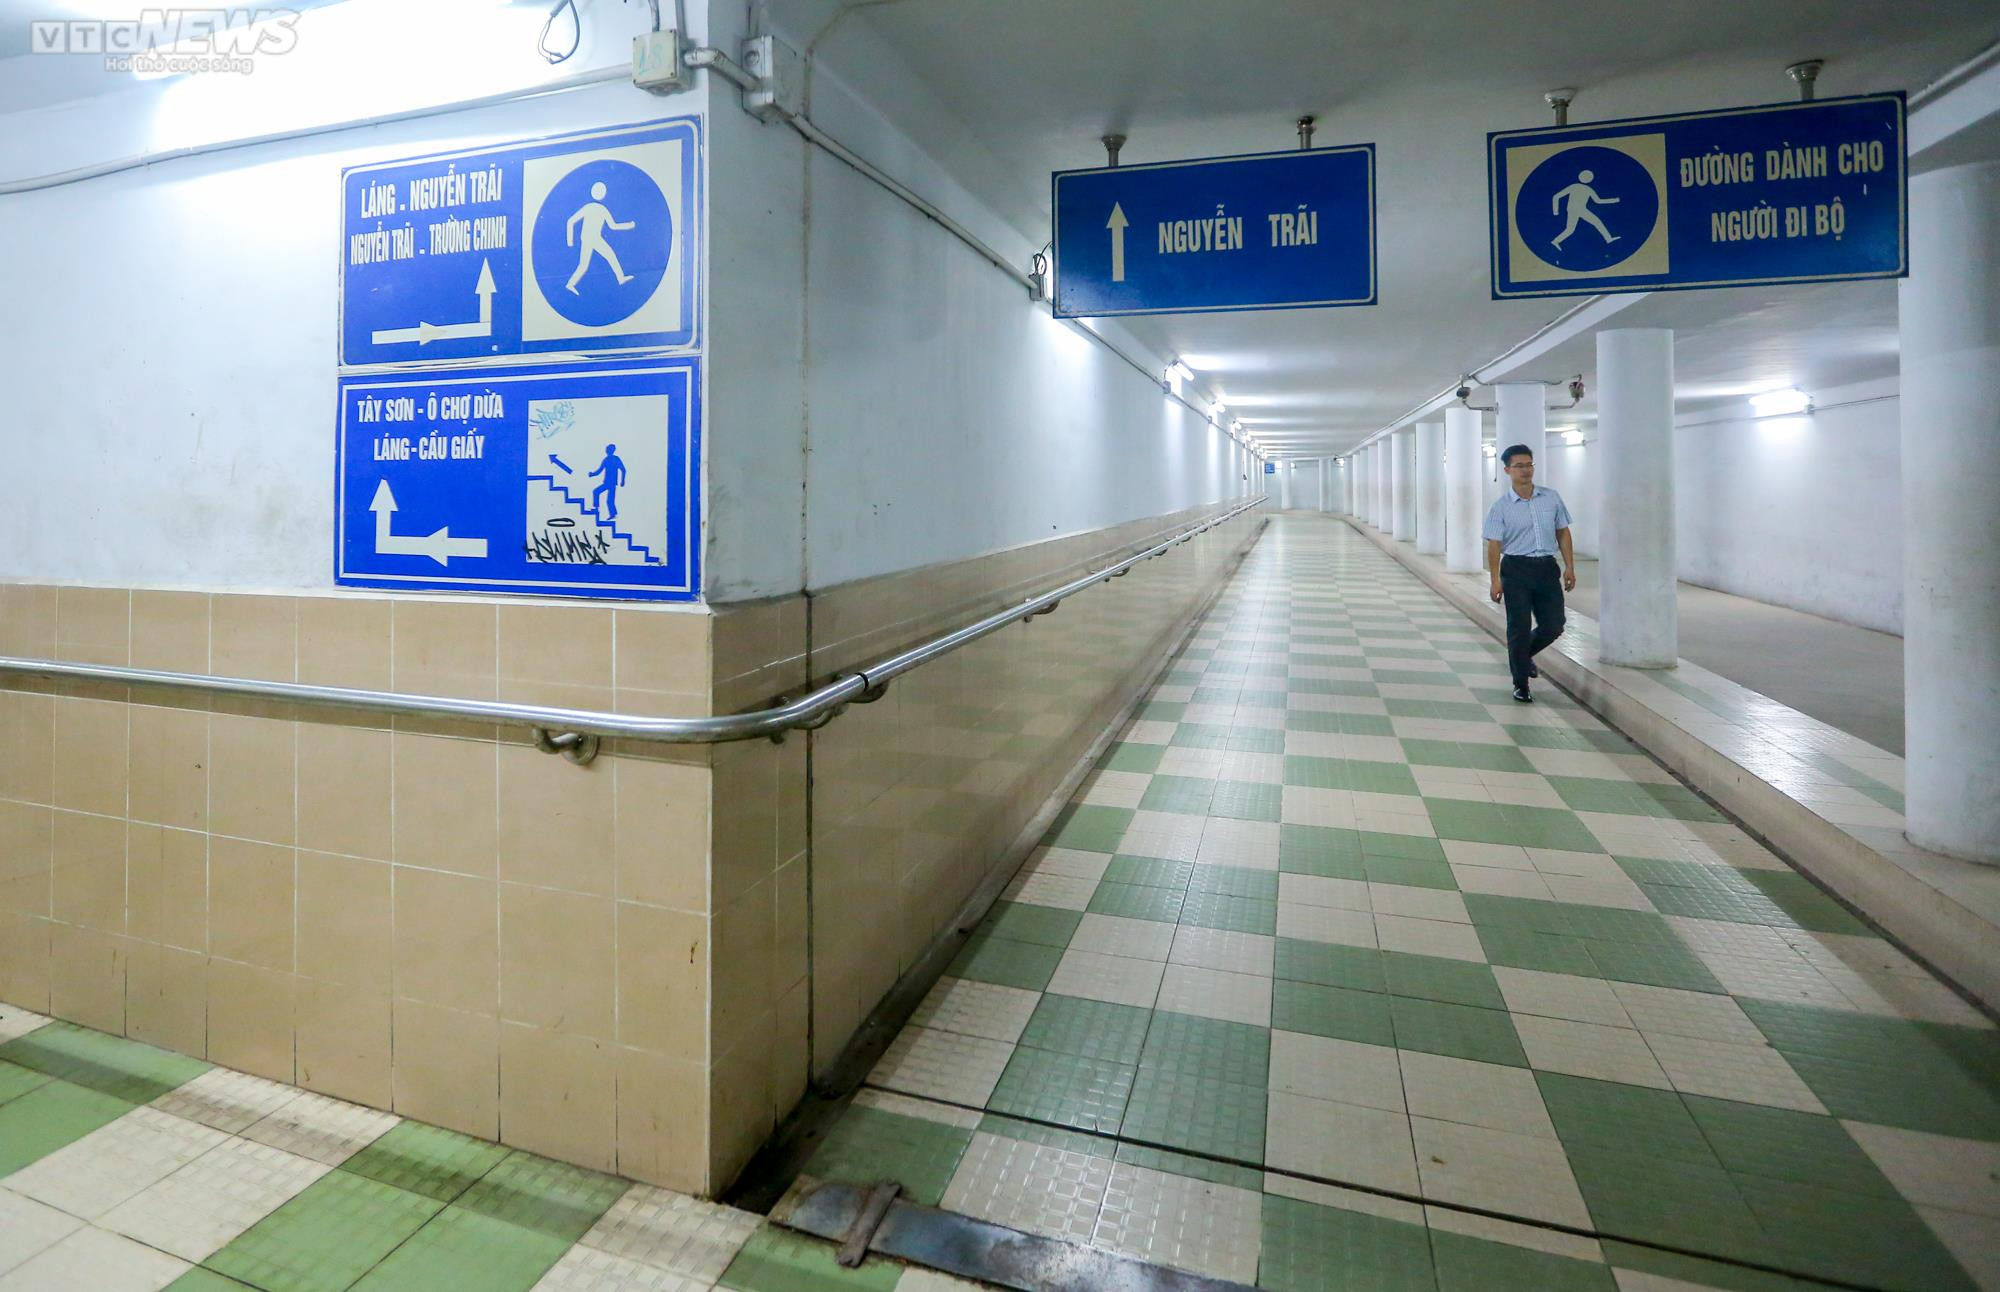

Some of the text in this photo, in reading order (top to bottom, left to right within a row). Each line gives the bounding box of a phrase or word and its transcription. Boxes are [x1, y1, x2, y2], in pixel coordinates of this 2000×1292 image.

[1680, 140, 1884, 188] ĐƯỜNG DÀNH CHO
[361, 180, 396, 219] LÁNG
[410, 163, 466, 211] NGUYỄN
[470, 163, 503, 204] TRÃI
[350, 221, 389, 265] NGUYỄN
[392, 221, 415, 260] TRÃI
[429, 214, 471, 255] TRƯỜNG
[473, 215, 507, 250] CHINH
[1158, 204, 1317, 254] NGUYỄN TRÃI
[1711, 196, 1845, 243] NGƯỜI ĐI BỘ
[357, 395, 382, 423] TÂY
[385, 397, 414, 422] SƠN
[427, 392, 438, 421] Ô
[440, 394, 471, 425] CHỢ
[473, 389, 504, 419] DỪA
[451, 428, 486, 460] GIẤY
